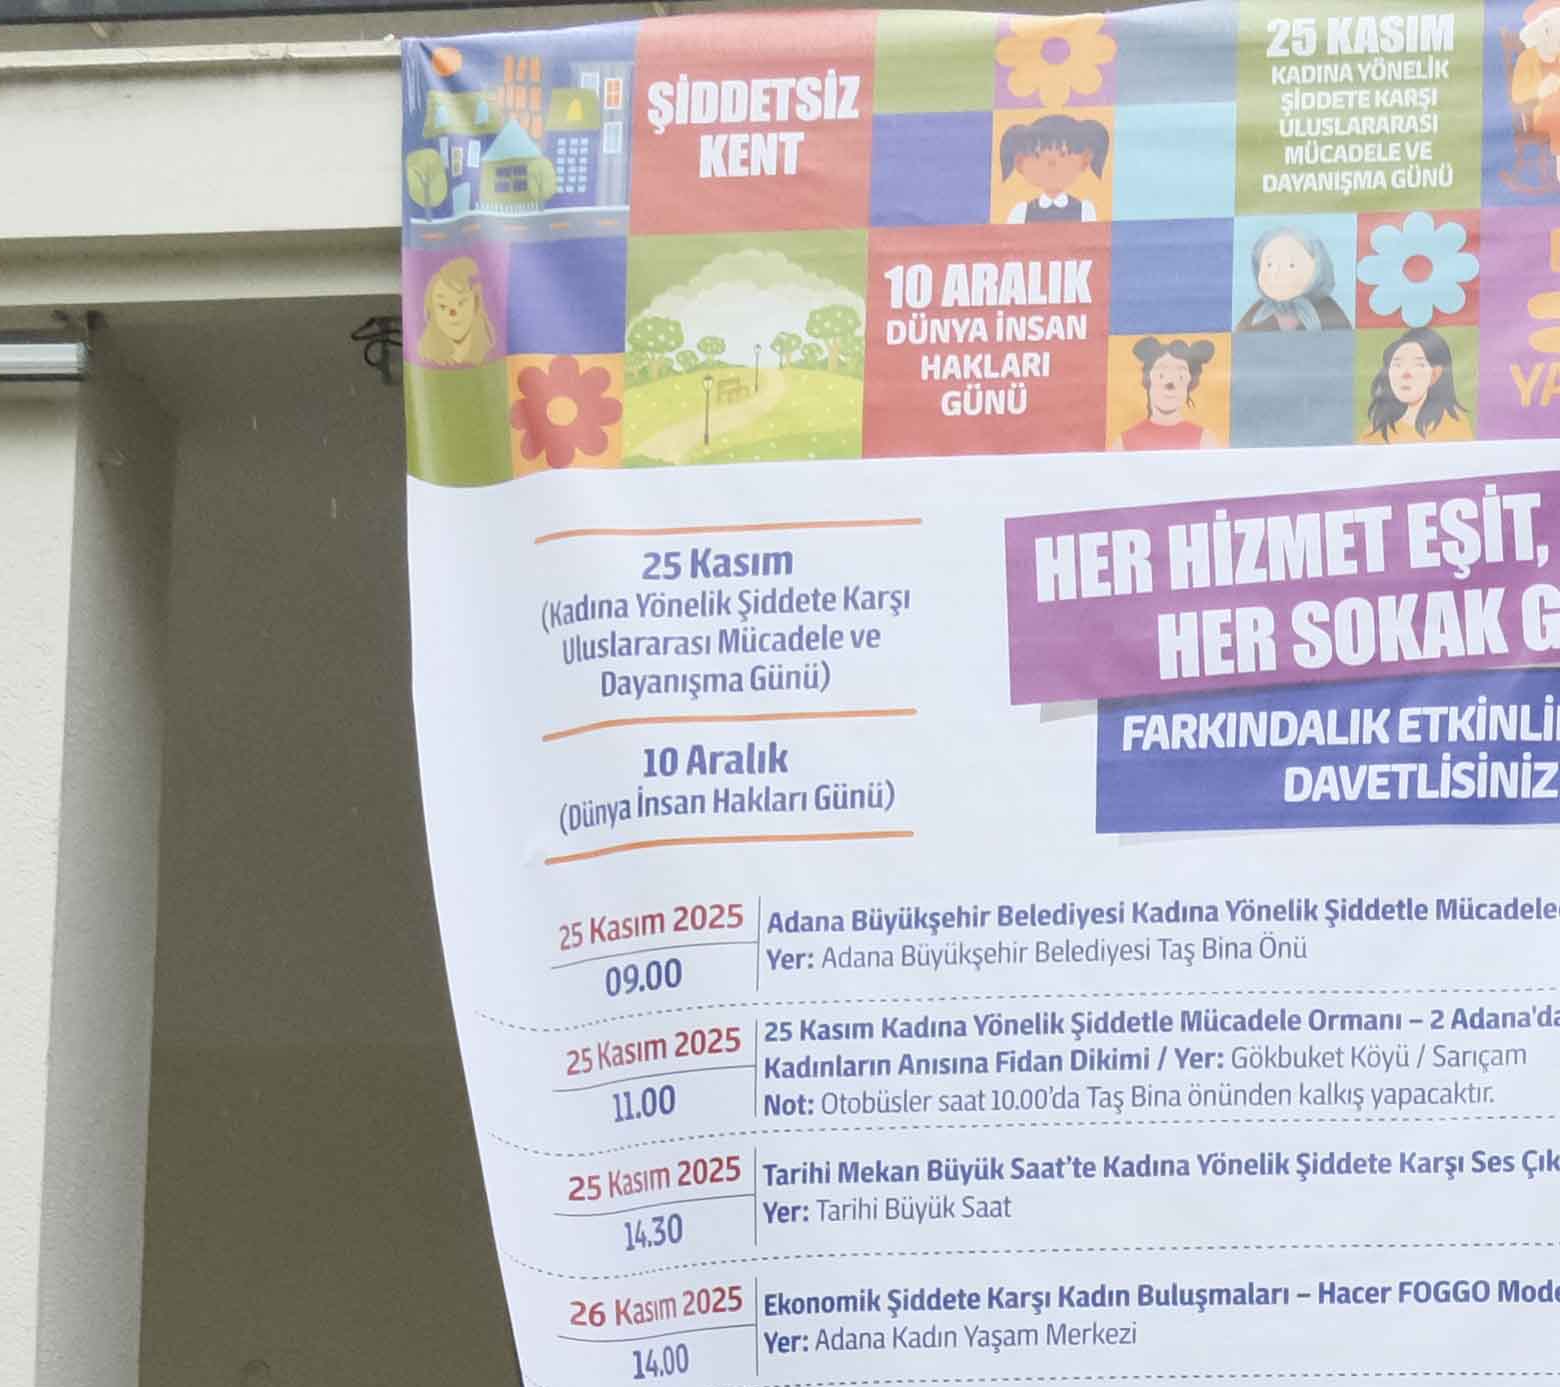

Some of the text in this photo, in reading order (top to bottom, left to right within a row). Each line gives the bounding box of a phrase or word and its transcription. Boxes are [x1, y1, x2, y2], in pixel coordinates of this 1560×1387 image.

[1266, 13, 1455, 58] 25 KASIM
[1272, 55, 1449, 85] KADINA YÖNELİK
[647, 67, 861, 135] ŞİDDETSİZ
[1281, 87, 1438, 116] ŞİDDETE KARŞI
[1279, 113, 1439, 138] ULUSLARARASI
[699, 131, 805, 179] KENT
[1284, 140, 1433, 165] MÜCADELE VE
[1262, 162, 1454, 196] DAYANIŞMA GÜNÜ
[884, 259, 1092, 309] 10 ARALIK
[886, 309, 1088, 346] DÜNYA İNSAN
[920, 351, 1051, 381] HAKLARI
[940, 380, 1028, 417] GÜNÜ
[641, 547, 794, 581] 25 Kasım
[1034, 484, 1550, 604] HER HİZMET EŞİT,
[541, 584, 911, 635] (Kadına Yönelik Şiddete Karşı
[562, 623, 881, 665] Uluslararası Mücadele ve
[1157, 605, 1277, 680] HER
[1291, 587, 1508, 669] SOKAK
[600, 659, 831, 701] Dayanışma Günü)
[1122, 707, 1391, 752] FARKINDALIK
[643, 740, 789, 779] 10 Aralık
[1283, 758, 1559, 803] DAVETLİSİNİZ
[559, 778, 896, 837] (Dünya İnsan Hakları Günü)
[559, 903, 744, 952] 25 Kasım 2025
[767, 909, 845, 935] Adana
[851, 904, 993, 937] Büyükşehir
[997, 900, 1125, 931] Belediyesi
[1132, 899, 1220, 924] Kadına
[1224, 897, 1319, 923] Yönelik
[1324, 896, 1429, 929] Şiddetle
[605, 957, 683, 998] 09.00
[566, 1026, 741, 1076] 25 Kasım 2025
[612, 1084, 676, 1123] 11.00
[763, 1093, 815, 1117] Not:
[821, 1088, 933, 1116] Otobüsler
[938, 1089, 986, 1113] saat
[1085, 1085, 1125, 1115] Taş
[1131, 1083, 1183, 1108] Bina
[1187, 1081, 1292, 1107] önünden
[1299, 1081, 1365, 1112] kalkış
[1370, 1080, 1495, 1111] yapacaktır.
[568, 1154, 742, 1202] 25 Kasım 2025
[762, 1194, 1012, 1225] Yer: Tarihi Büyük Saat
[623, 1212, 683, 1252] 14.30
[569, 1285, 743, 1328] 26 Kasım 2025
[632, 1342, 690, 1380] 14.00
